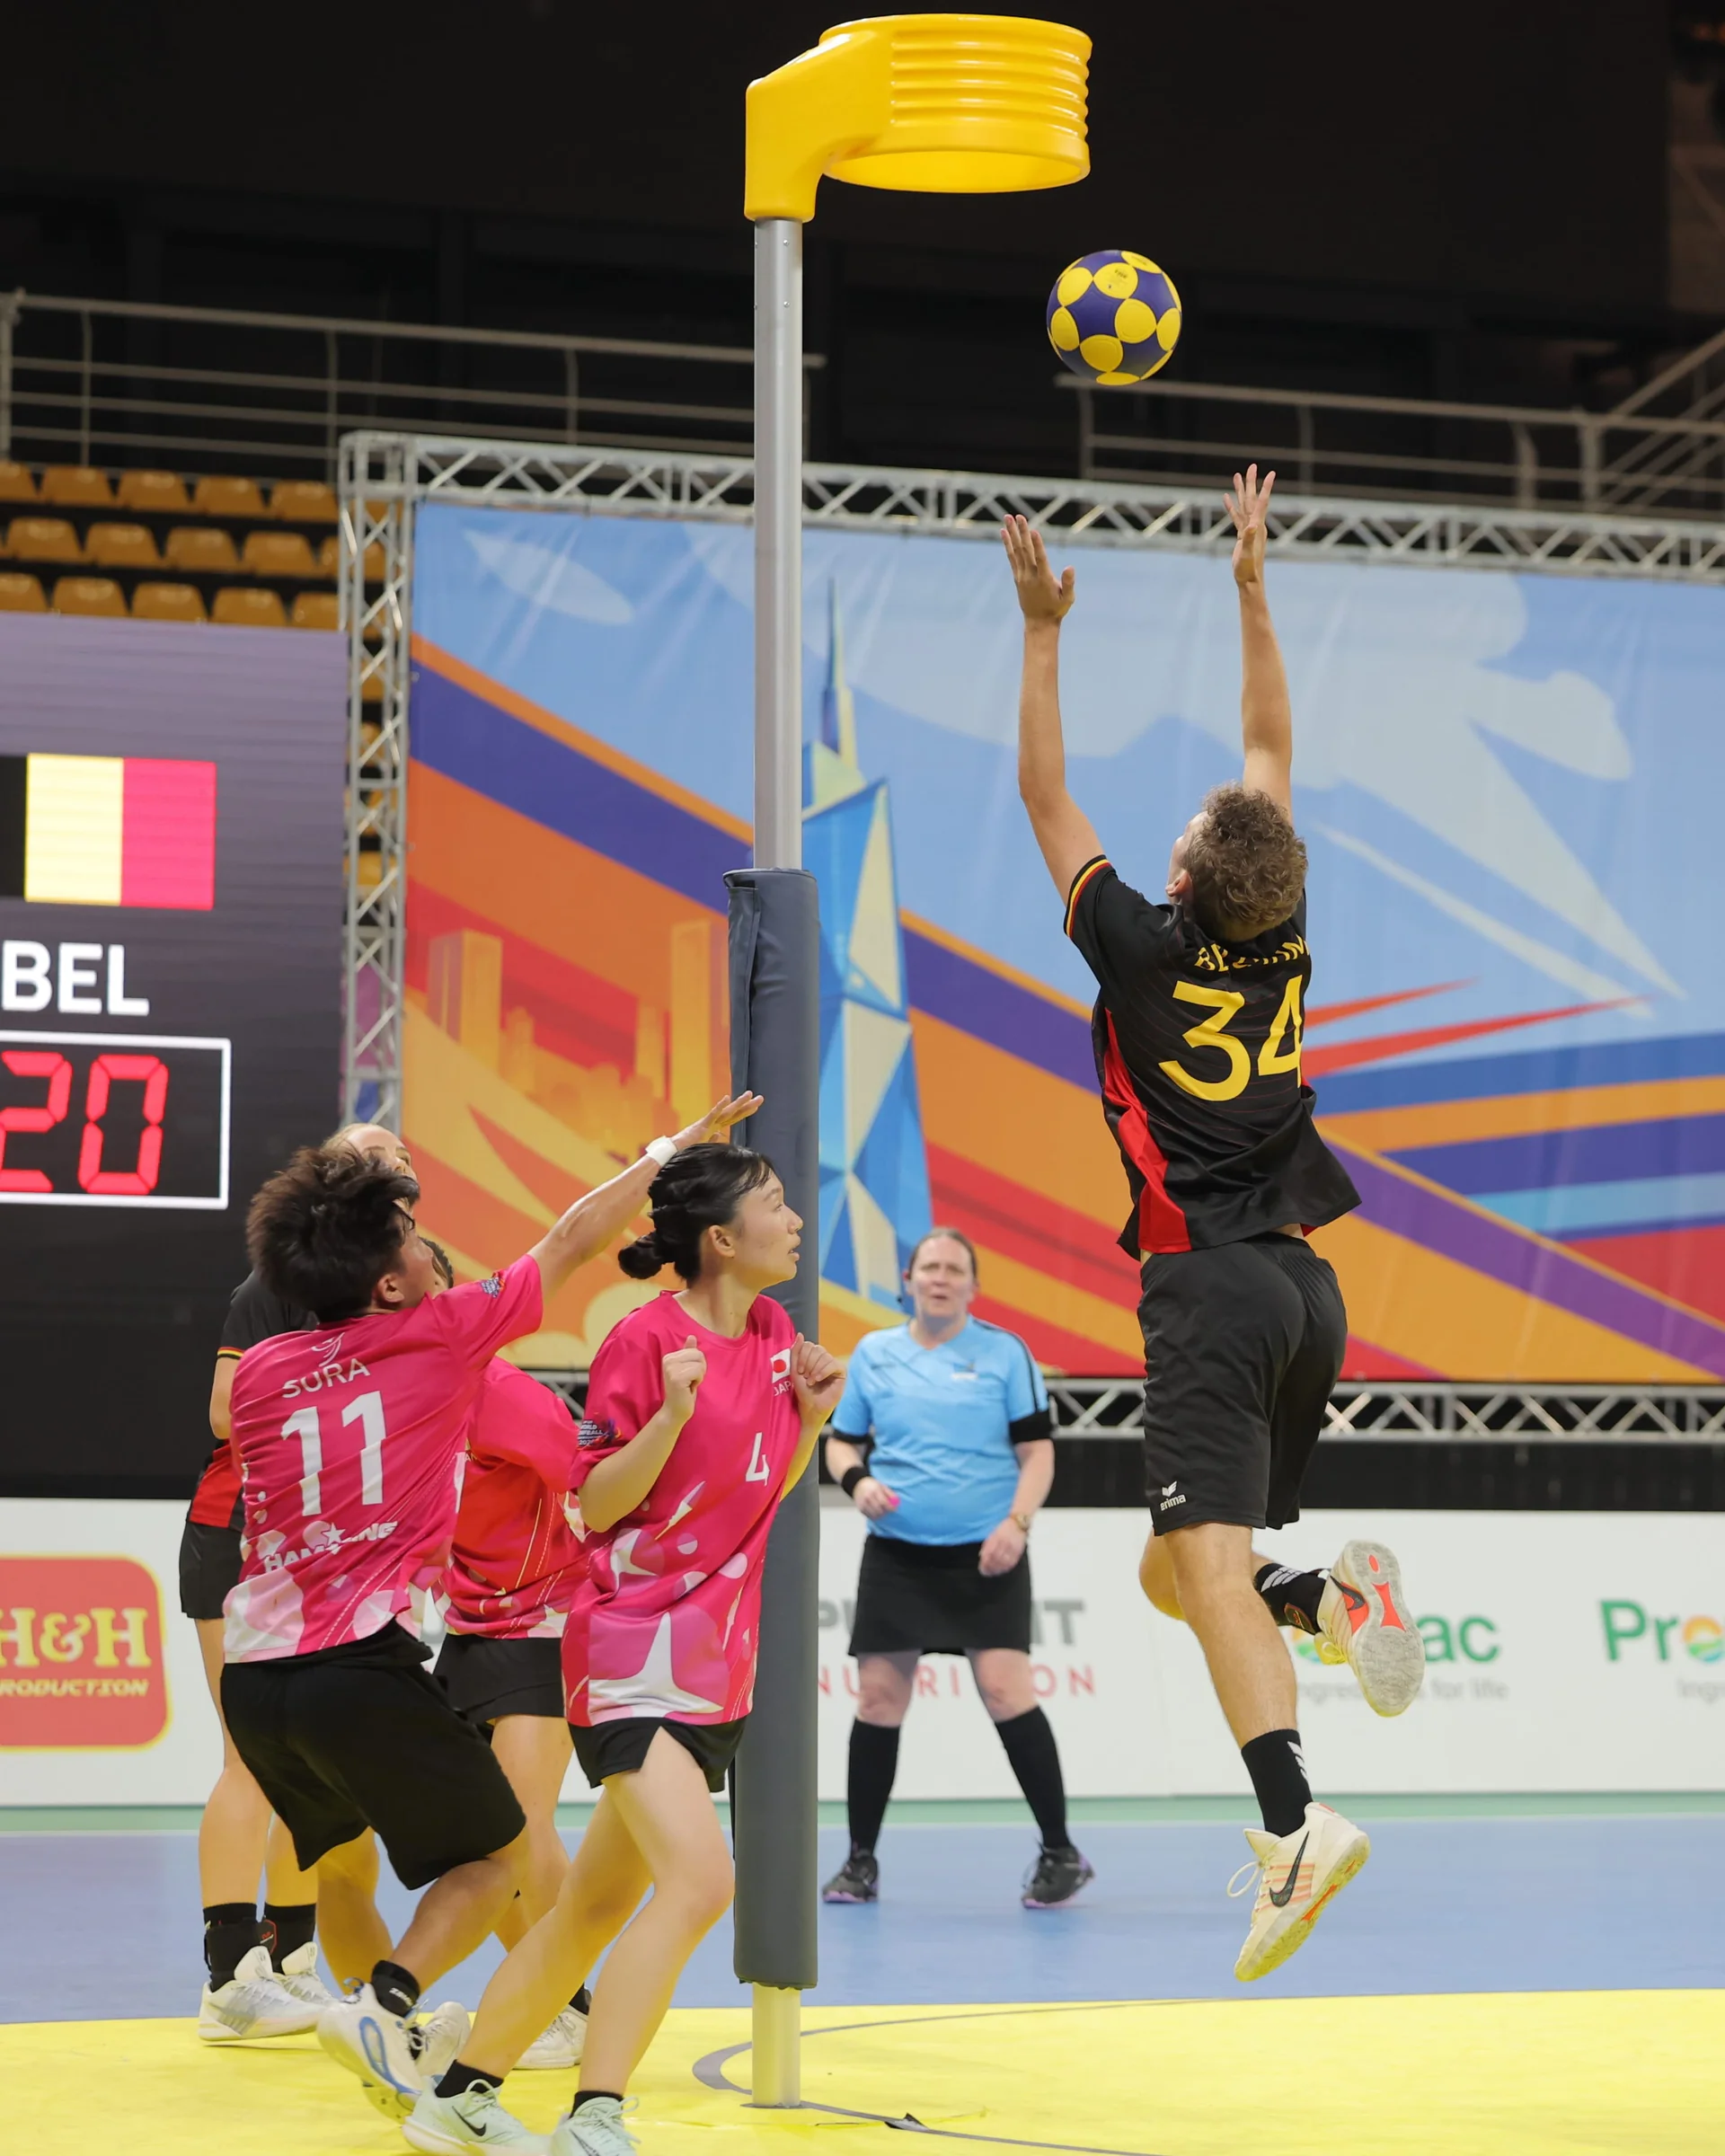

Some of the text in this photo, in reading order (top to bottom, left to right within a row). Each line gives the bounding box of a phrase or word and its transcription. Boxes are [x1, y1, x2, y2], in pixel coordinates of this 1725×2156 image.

[1, 940, 150, 1016] BEL
[1158, 975, 1303, 1101] 34
[0, 1050, 169, 1195] 20
[282, 1357, 371, 1398] SURA
[774, 1380, 794, 1397] JAP
[280, 1390, 387, 1516] 11
[746, 1432, 770, 1487] 4
[1160, 1494, 1187, 1512] erima
[0, 1606, 152, 1668] H&H
[0, 1678, 151, 1698] RODUCTION
